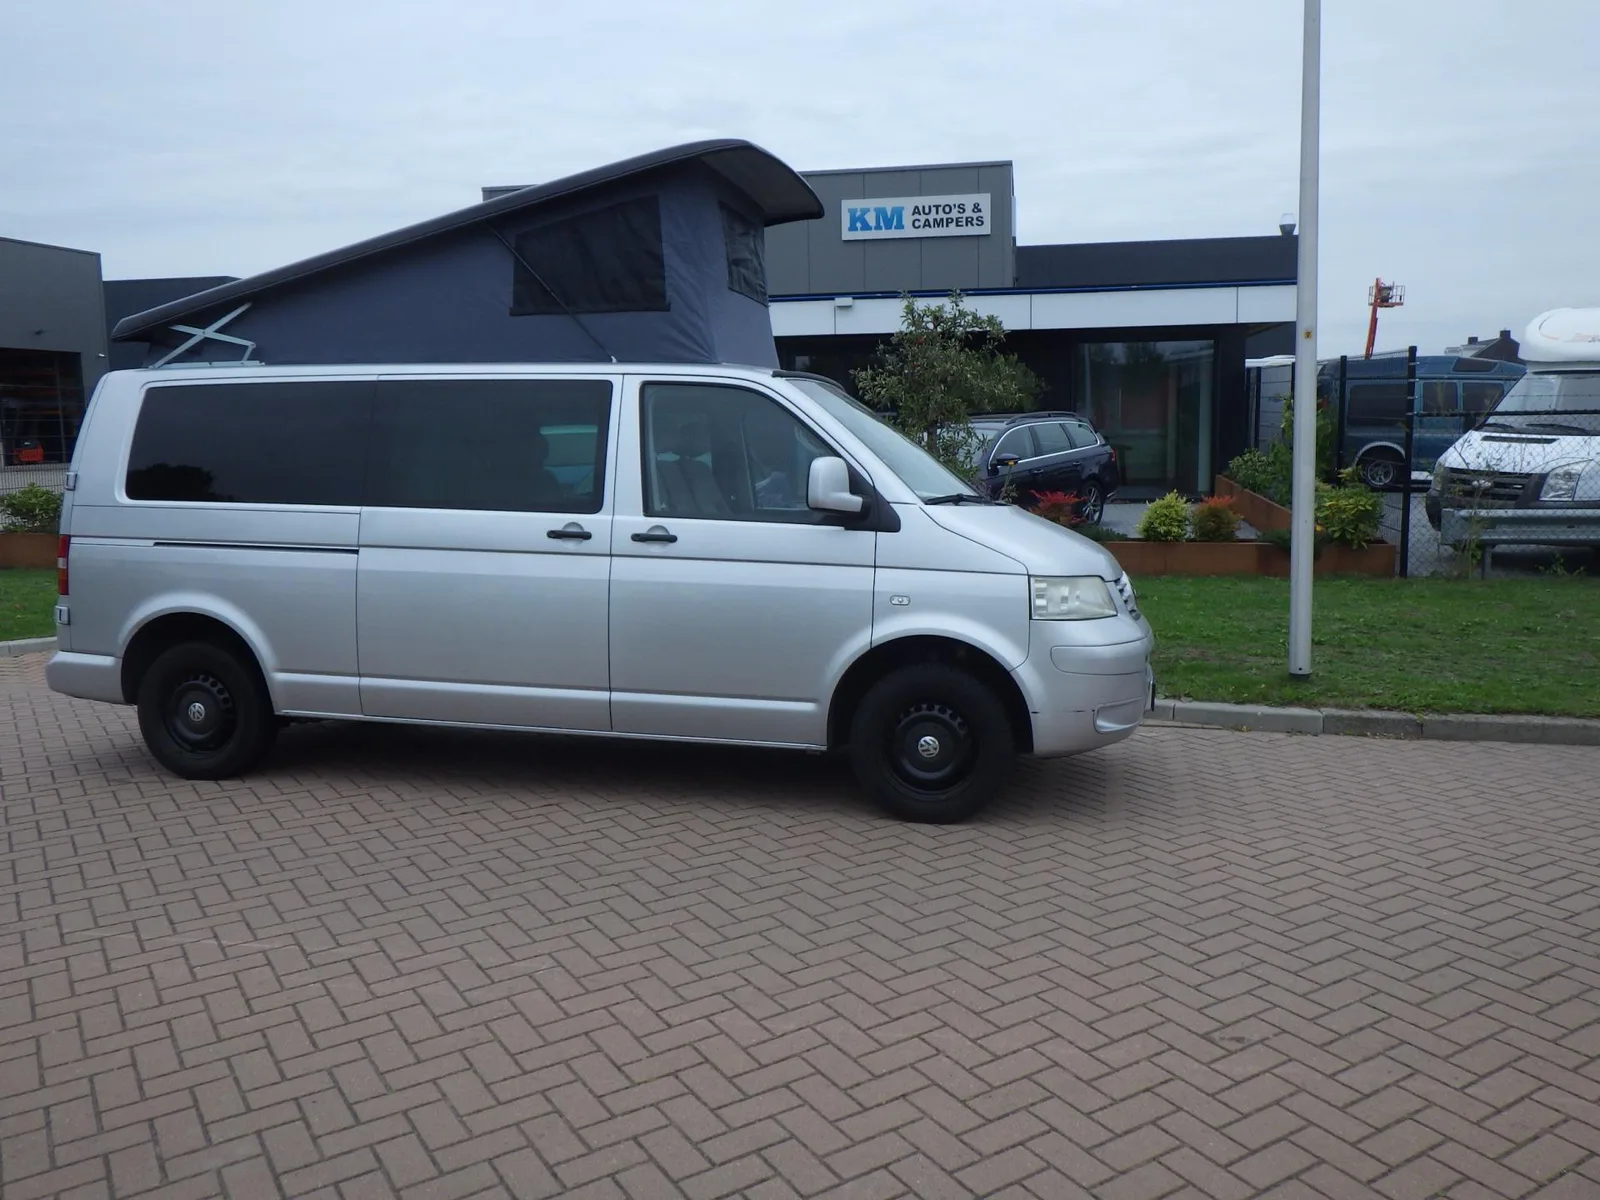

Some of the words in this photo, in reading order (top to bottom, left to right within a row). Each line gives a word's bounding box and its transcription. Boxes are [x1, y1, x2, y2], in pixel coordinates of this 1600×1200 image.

[911, 203, 966, 216] AUTO'S
[971, 202, 982, 214] &
[847, 206, 905, 232] KM
[911, 215, 985, 230] CAMPERS
